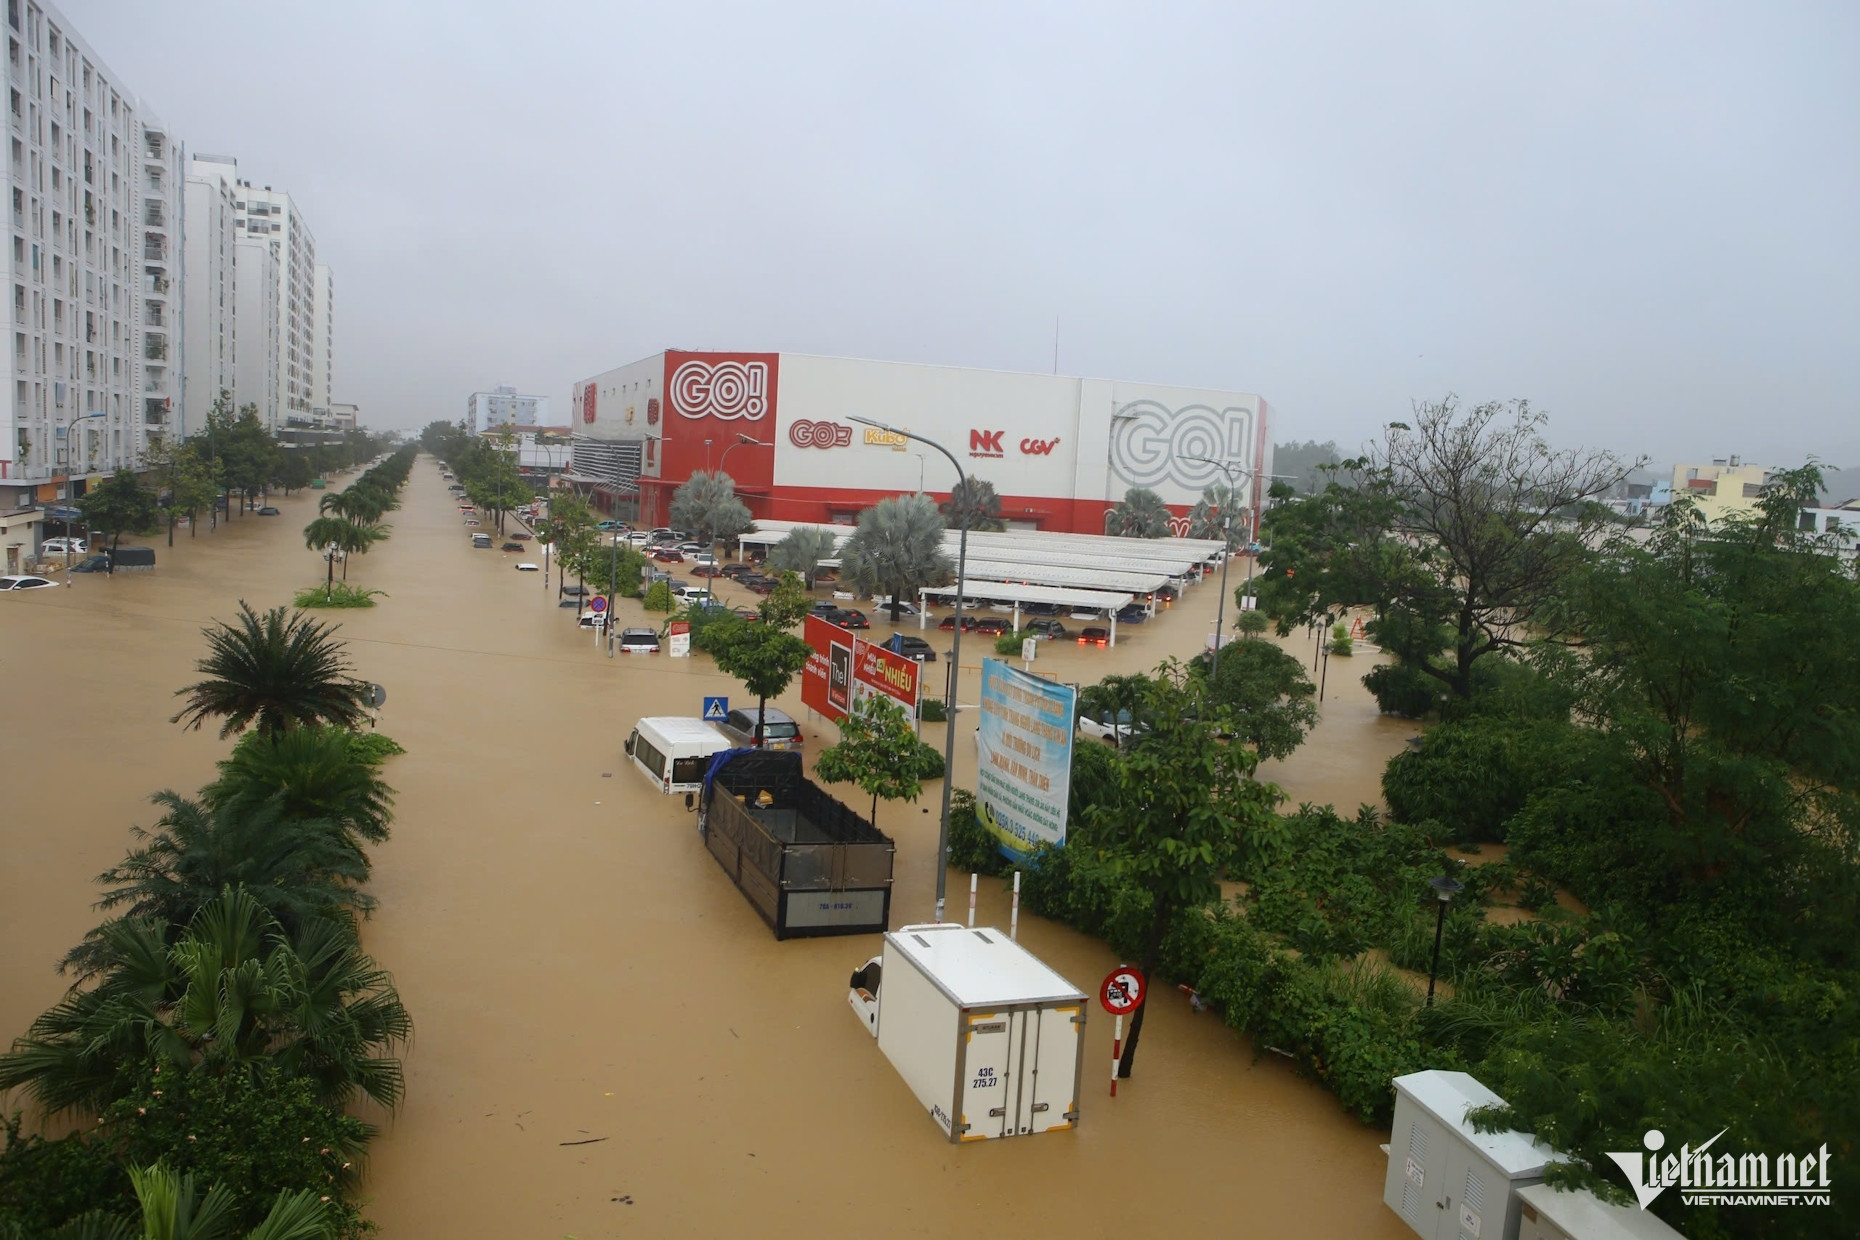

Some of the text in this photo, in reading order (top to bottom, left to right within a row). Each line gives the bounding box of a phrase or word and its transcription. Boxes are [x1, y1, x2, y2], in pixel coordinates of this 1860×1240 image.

[670, 360, 768, 421] GO!
[970, 429, 1005, 452] NK
[1020, 437, 1055, 455] CGV
[1110, 399, 1252, 492] GO!
[832, 662, 844, 684] The
[1015, 822, 1026, 841] 525
[978, 1067, 993, 1077] 43C
[973, 1077, 997, 1088] 275.27
